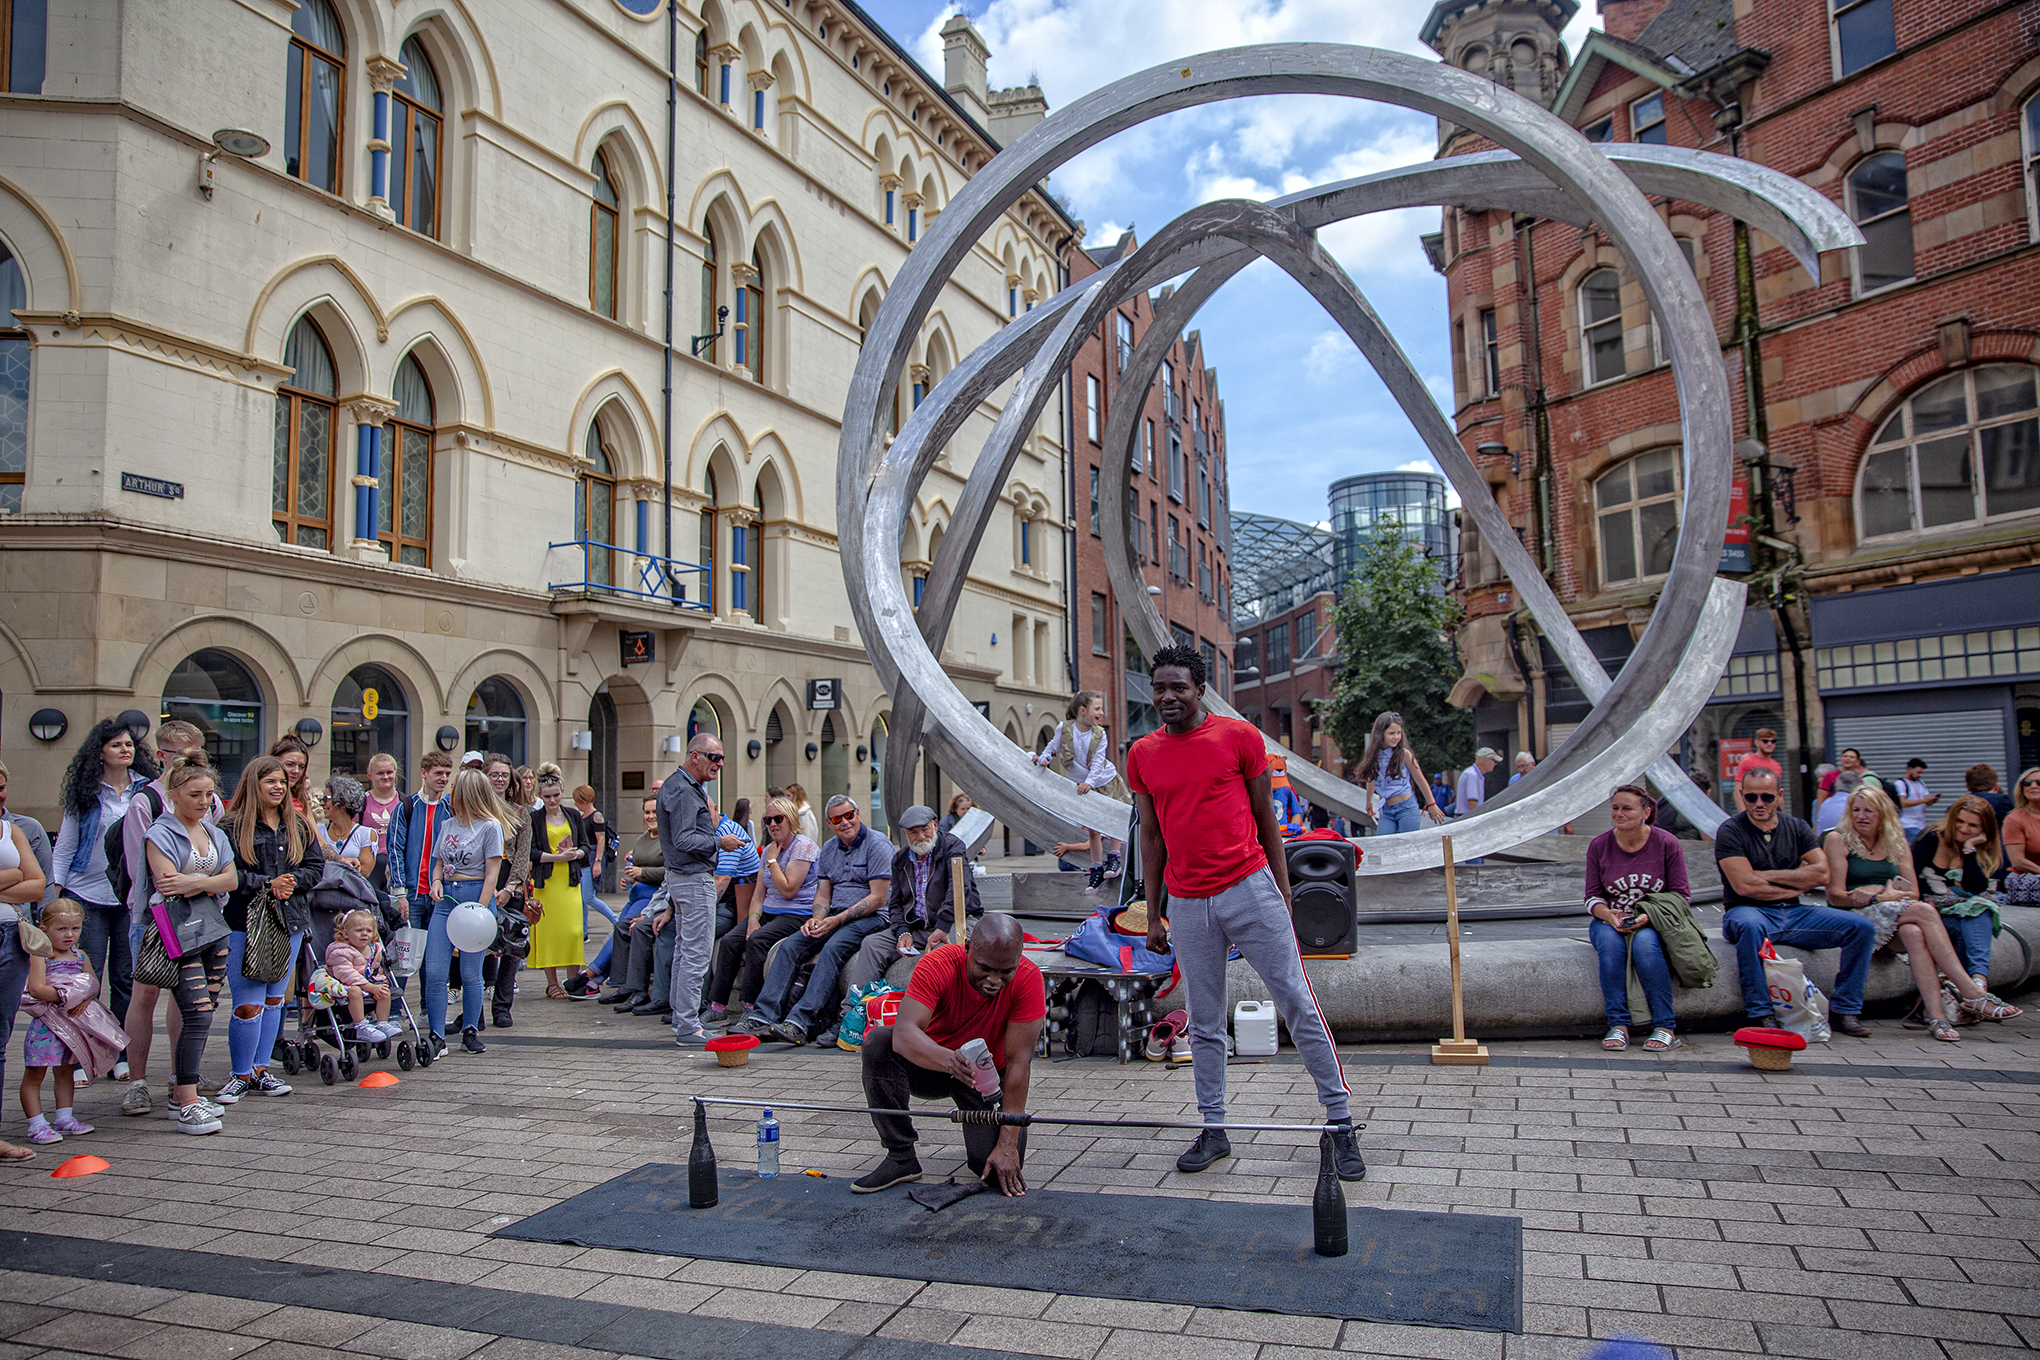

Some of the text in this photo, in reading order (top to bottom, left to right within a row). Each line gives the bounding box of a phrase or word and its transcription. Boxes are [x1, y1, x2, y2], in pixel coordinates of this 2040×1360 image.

[125, 476, 164, 493] ARTHUR
[1725, 766, 1738, 777] LE
[1606, 873, 1665, 897] SUPER
